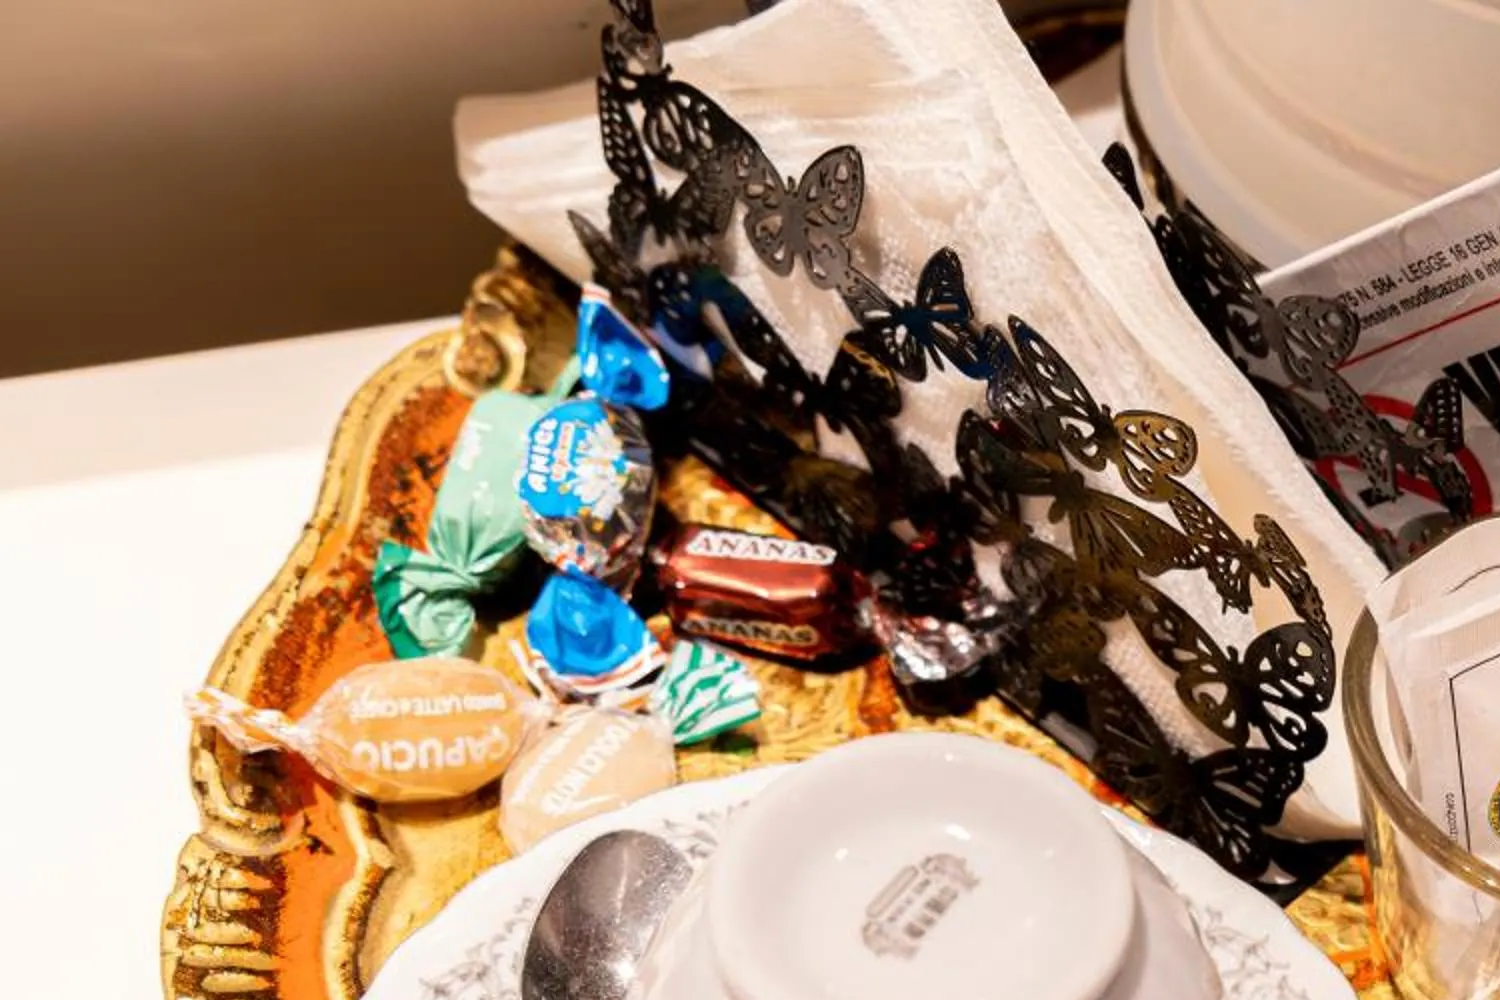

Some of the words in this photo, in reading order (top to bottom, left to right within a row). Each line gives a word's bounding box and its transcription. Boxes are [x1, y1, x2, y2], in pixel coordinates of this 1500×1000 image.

[1400, 251, 1452, 284] LEGGE
[1465, 231, 1500, 256] GEN.
[699, 534, 832, 563] ANANAS
[686, 619, 816, 645] ANANAS
